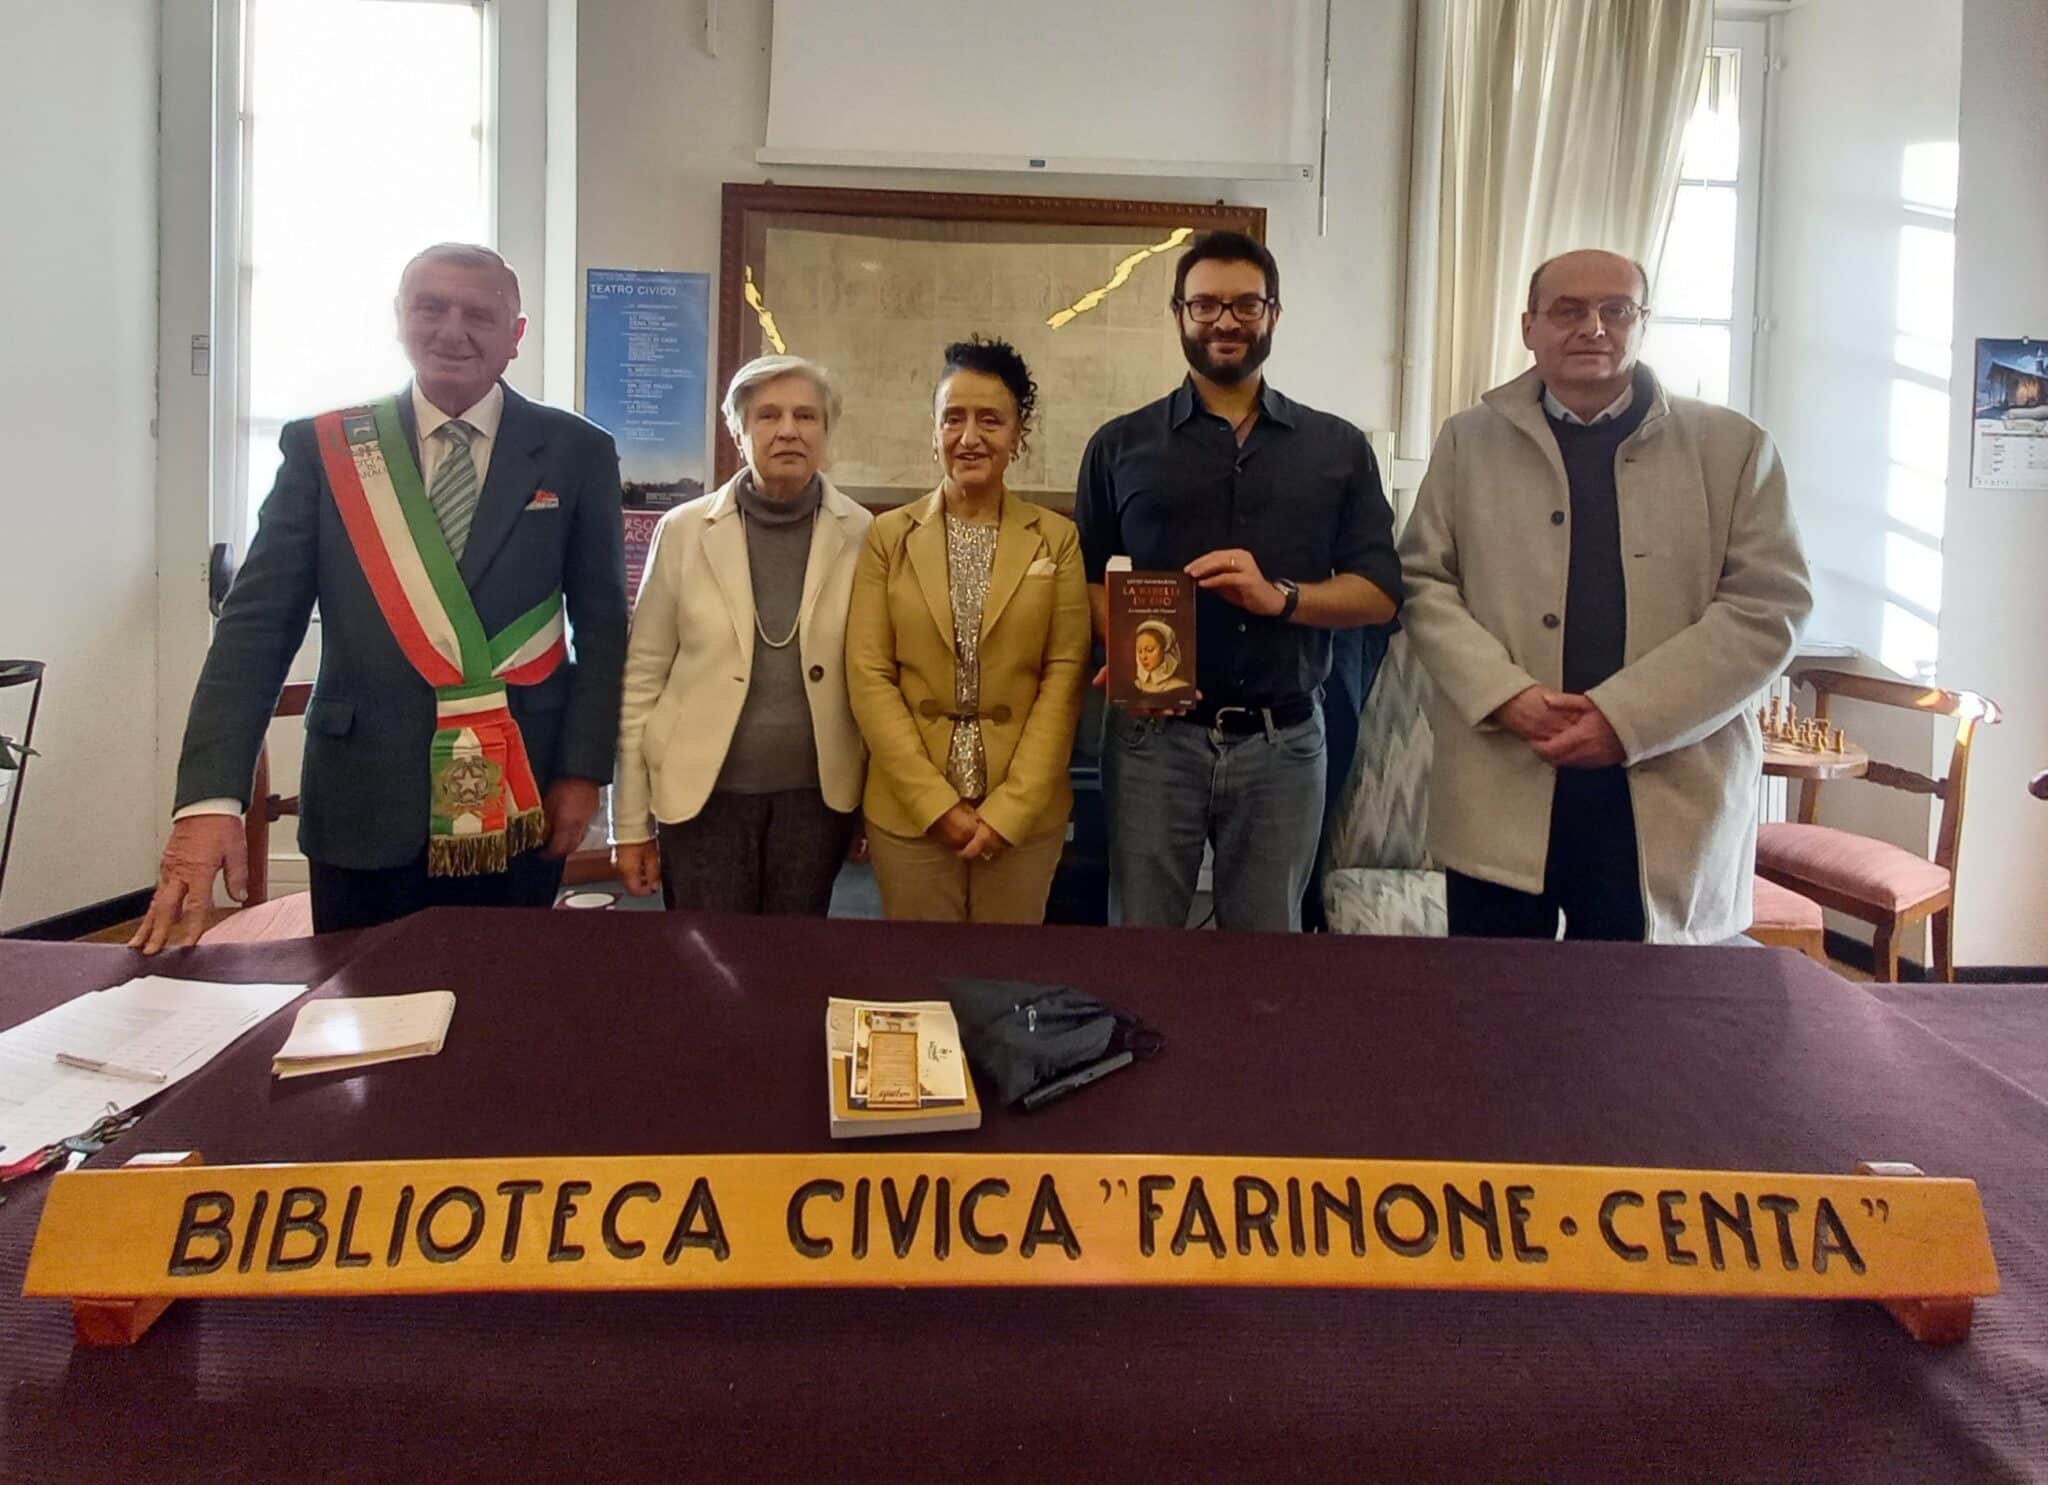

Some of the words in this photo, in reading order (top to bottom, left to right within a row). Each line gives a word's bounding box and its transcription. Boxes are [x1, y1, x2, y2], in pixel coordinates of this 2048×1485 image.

[591, 284, 634, 295] TEATRO
[637, 286, 677, 296] CIVICO
[168, 1176, 730, 1277] BIBLIOTECA
[786, 1174, 1082, 1261] CIVICA
